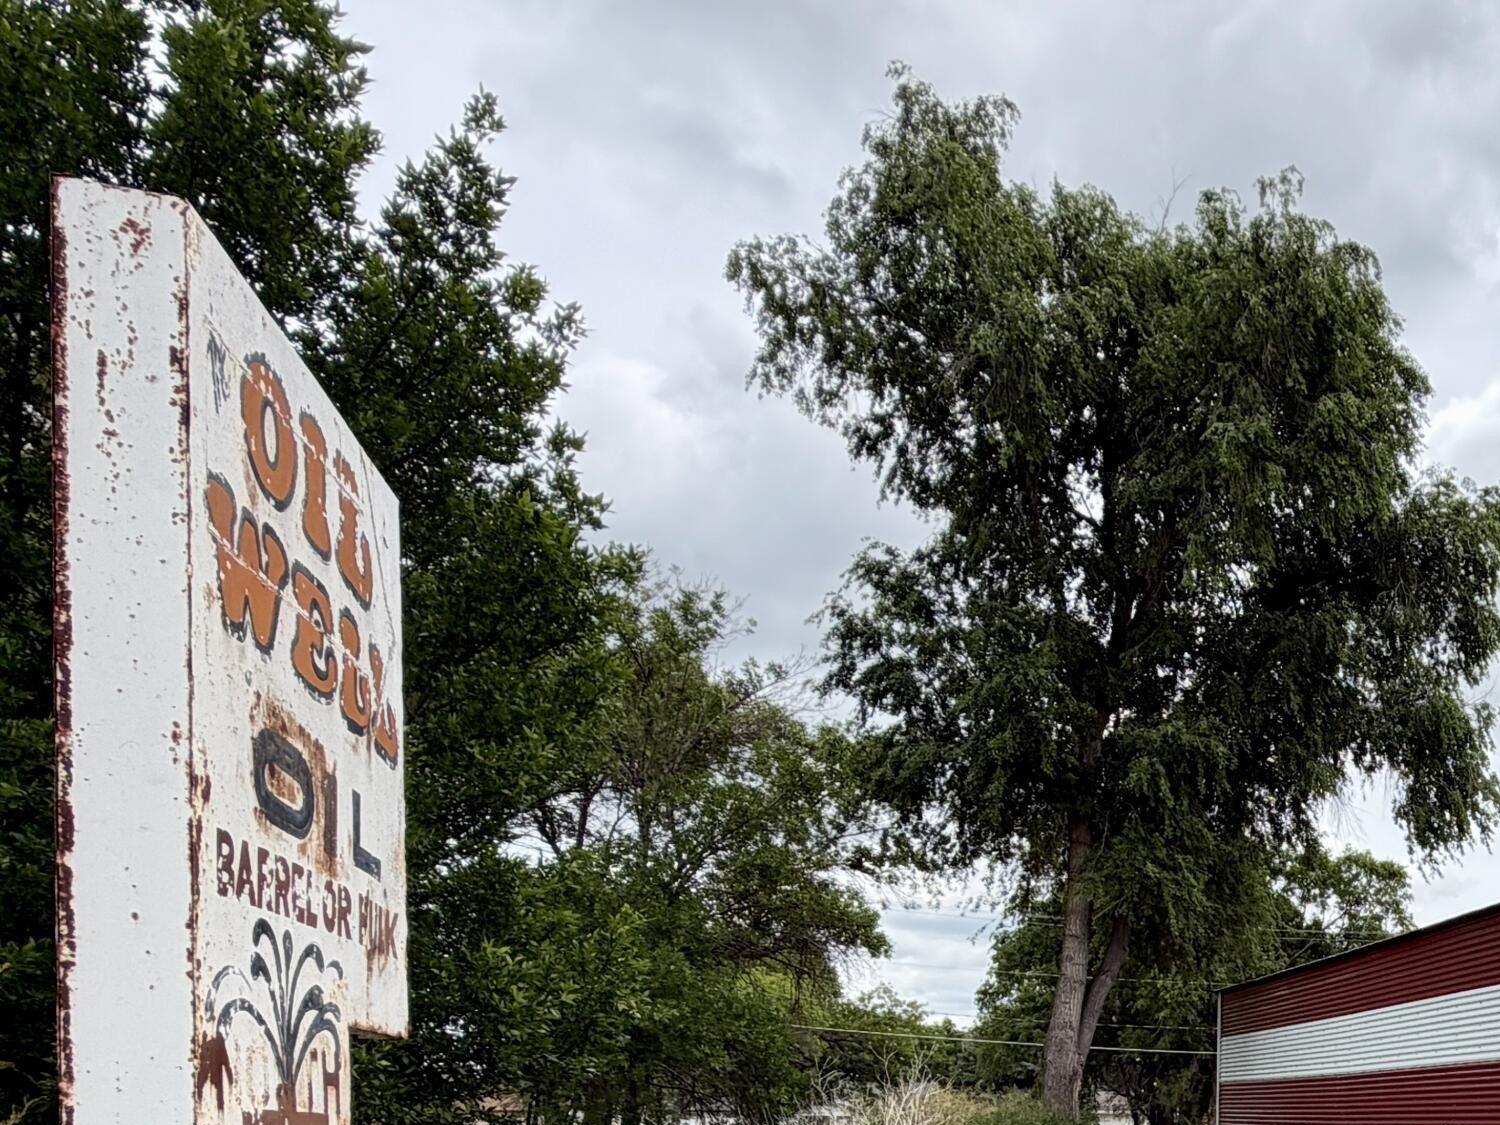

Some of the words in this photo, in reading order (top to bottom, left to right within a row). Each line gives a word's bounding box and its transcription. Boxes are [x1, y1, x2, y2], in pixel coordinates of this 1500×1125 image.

[241, 351, 374, 612] OIL
[251, 727, 382, 882] OIL
[216, 827, 319, 929] BARREL
[322, 880, 353, 941] OR
